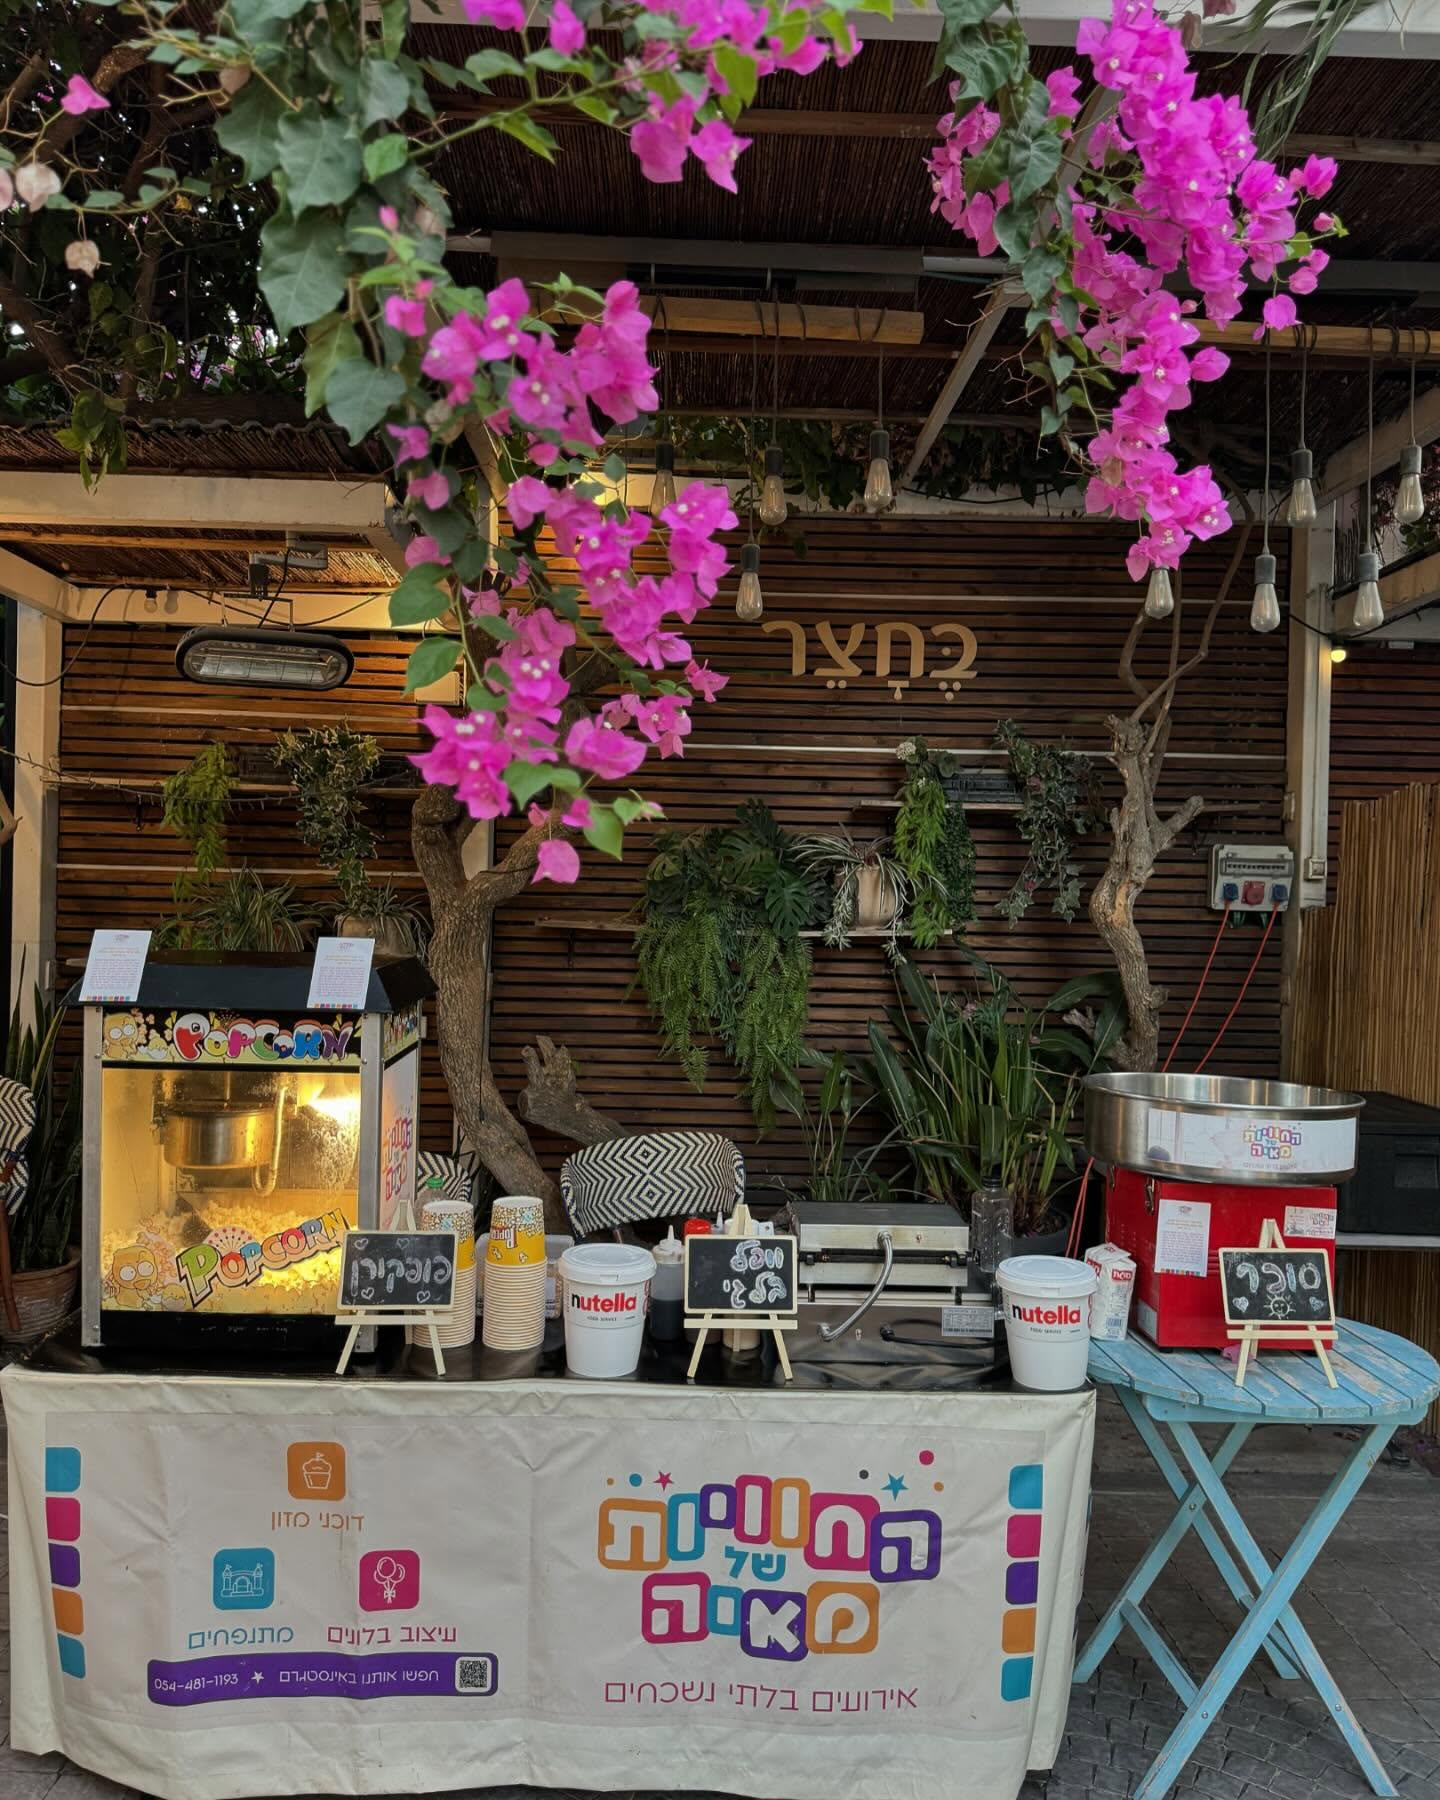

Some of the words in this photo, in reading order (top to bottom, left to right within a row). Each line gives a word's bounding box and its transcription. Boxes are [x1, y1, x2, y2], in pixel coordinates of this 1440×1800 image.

[1243, 1126, 1301, 1145] החוויות
[1251, 1143, 1292, 1159] מאיה
[176, 1208, 350, 1307] POPCORN
[351, 1255, 452, 1297] פופקורן
[1236, 1262, 1321, 1294] סוכר
[571, 1292, 637, 1312] nutella
[1012, 1303, 1080, 1325] nutella
[271, 1511, 310, 1531] מזון
[319, 1512, 364, 1532] דוכני
[598, 1474, 942, 1582] החוויות
[724, 1545, 786, 1582] של
[642, 1571, 880, 1661] מאיה
[188, 1626, 294, 1650] מתנפחים
[327, 1626, 391, 1646] בלונים
[400, 1626, 456, 1643] עיצוב
[154, 1672, 239, 1692] 054-481-1193
[279, 1670, 357, 1684] באינסטגרם
[362, 1671, 398, 1684] אותנו
[402, 1670, 439, 1682] חפשו
[605, 1681, 716, 1704] נשכחים
[728, 1684, 799, 1711] בלתי
[812, 1688, 918, 1712] אירועים
